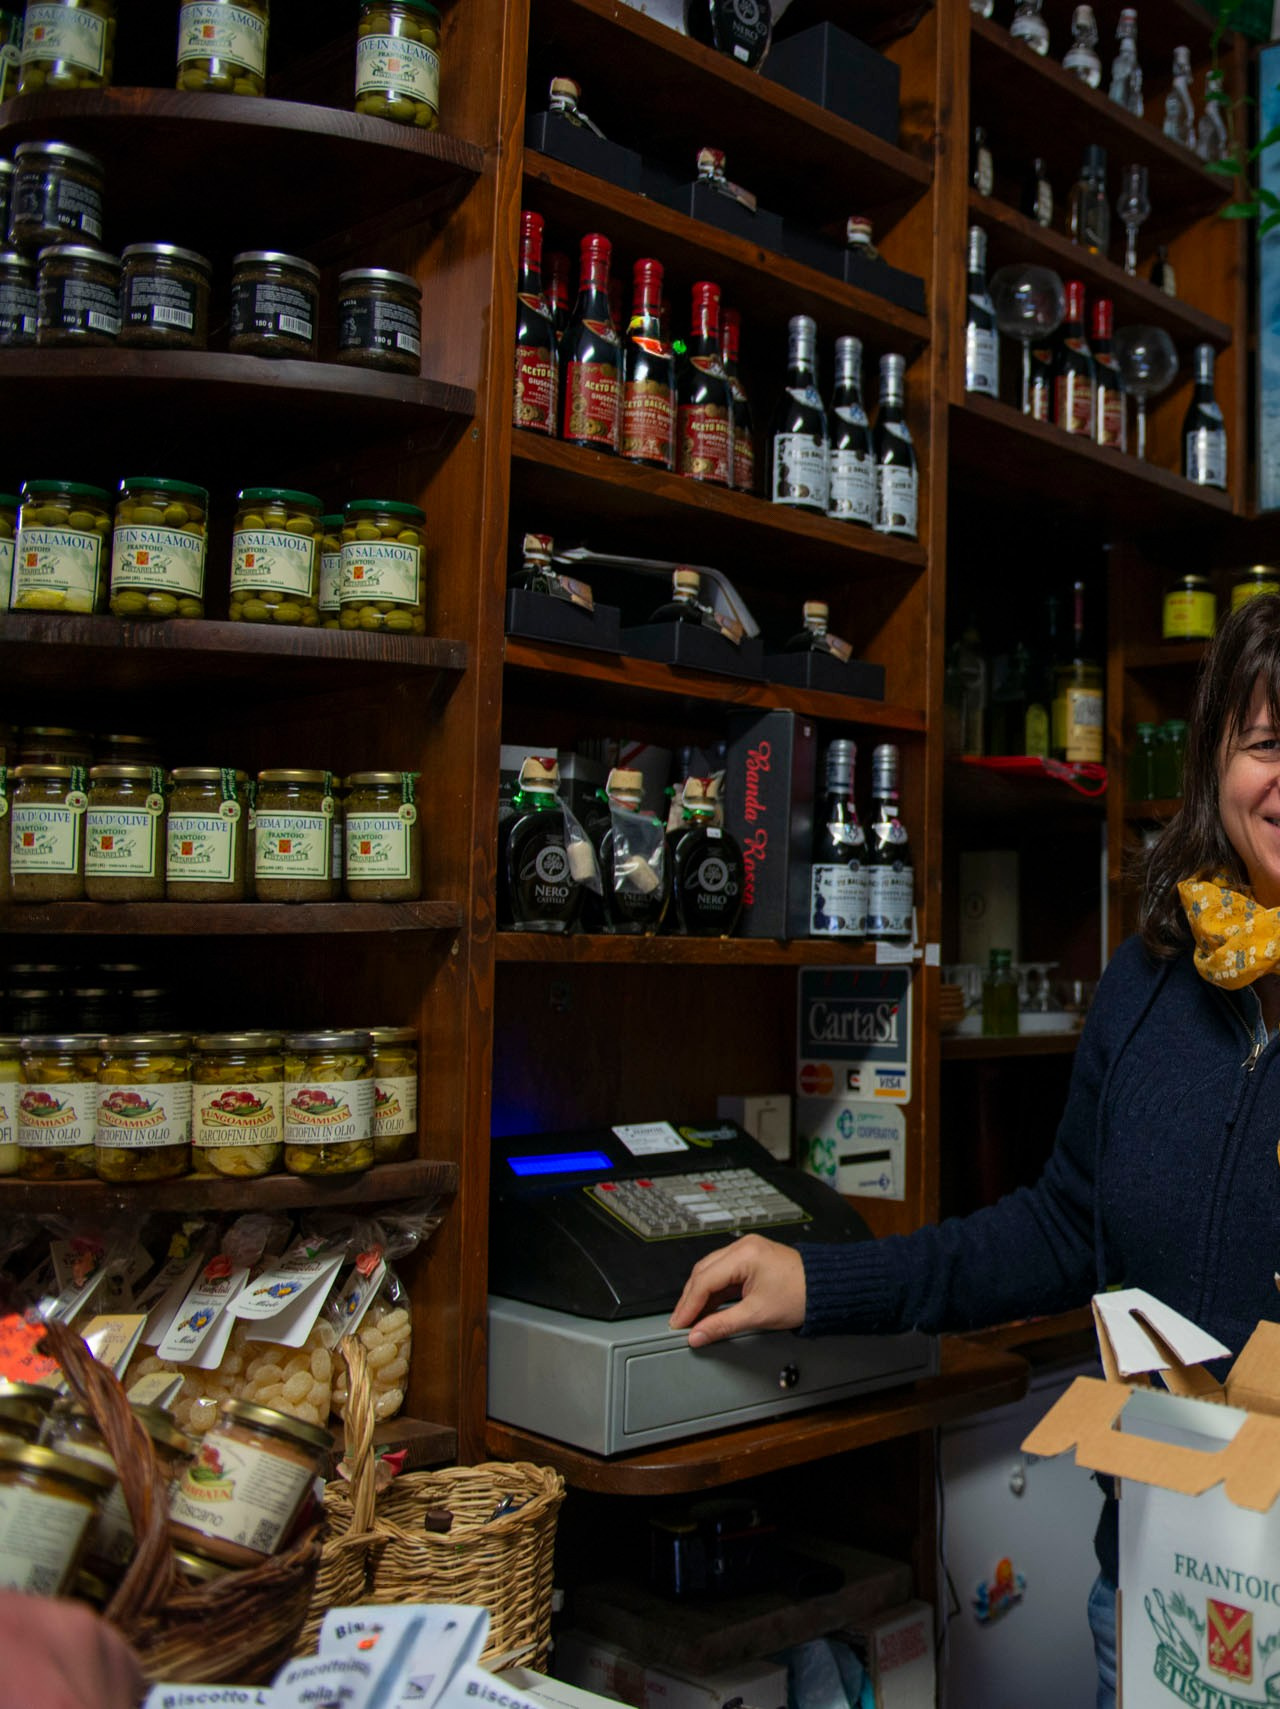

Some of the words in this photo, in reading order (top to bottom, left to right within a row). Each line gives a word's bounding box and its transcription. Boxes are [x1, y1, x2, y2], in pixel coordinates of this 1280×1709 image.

[30, 534, 94, 551] SALAMOIA
[141, 532, 201, 553] SALAMOIA
[248, 534, 308, 553] SALAMOIA
[355, 546, 413, 562] SALAMOIA
[39, 811, 70, 823] OLIVE
[117, 815, 149, 826] OLIVE
[197, 821, 228, 832] OLIVE
[295, 819, 323, 830] OLIVE
[374, 821, 402, 831] OLIVE
[534, 884, 569, 897] NERO
[696, 893, 727, 904] NERO
[879, 1077, 902, 1089] VISA
[104, 1112, 164, 1128] NGOAMIATA
[386, 1118, 404, 1130] OLIO
[45, 1128, 56, 1140] IN
[57, 1127, 81, 1140] OLIO
[135, 1128, 147, 1141] IN
[148, 1128, 170, 1141] OLIO
[199, 1127, 247, 1142] CARCIOFINI
[247, 1126, 259, 1140] IN
[260, 1126, 278, 1139] OLIO
[322, 1125, 333, 1138] IN
[335, 1125, 356, 1137] OLIO
